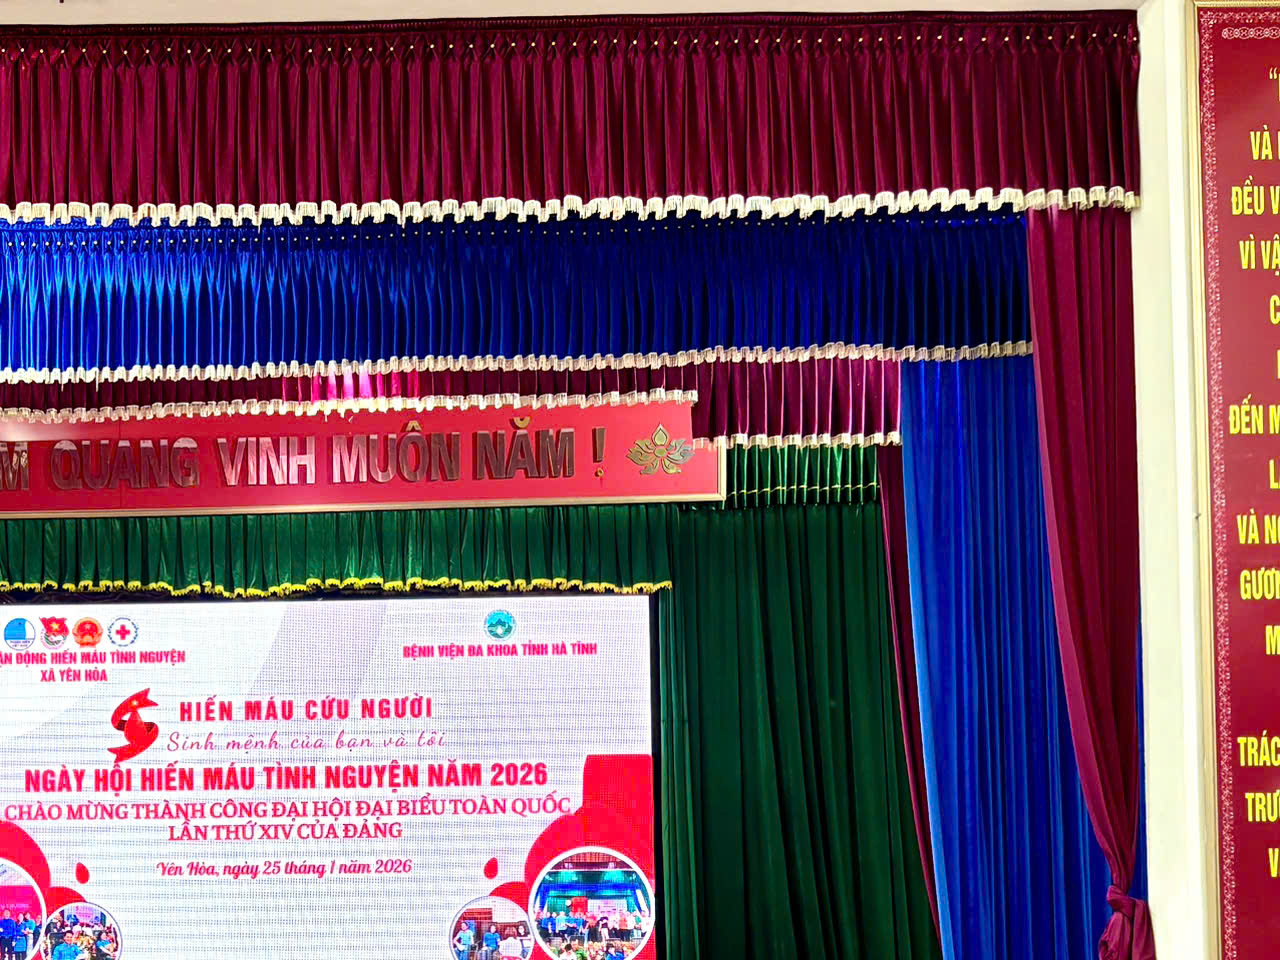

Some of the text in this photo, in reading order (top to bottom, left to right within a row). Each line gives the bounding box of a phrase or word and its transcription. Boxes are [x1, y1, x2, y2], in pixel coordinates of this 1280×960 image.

[1250, 124, 1273, 161] VÀ
[1231, 175, 1265, 215] ĐỀU
[1239, 234, 1256, 270] VÌ
[1229, 393, 1264, 435] ĐẾN
[51, 437, 200, 490] QUANG
[217, 436, 315, 485] VINH
[330, 420, 460, 483] MUÔN
[472, 416, 575, 479] NĂM
[1236, 508, 1260, 545] VÀ
[81, 649, 106, 664] MÁU
[140, 648, 185, 666] NGUYỆN
[403, 643, 434, 661] BỆNH
[438, 642, 465, 660] VIỆN
[487, 643, 518, 657] KHOA
[552, 640, 568, 656] HÀ
[59, 667, 81, 682] YÊN
[180, 692, 432, 721] HIẾN MÁU CỨU NGƯỜI
[167, 729, 445, 754] Sinh mệnh của bạn và tôi
[25, 759, 548, 797] NGÀY HỘI HIẾN MÁU TÌNH NGUYỆN NĂM 2026
[4, 790, 571, 822] CHÀO MỪNG THÀNH CÔNG ĐẠI HỘI ĐẠI BIỂU TOÀN QUỐC
[211, 820, 258, 841] THỨ
[258, 825, 294, 840] XIV
[297, 819, 339, 840] CỦA
[343, 819, 403, 839] ĐẢNG
[157, 859, 412, 879] Yên Hòa, ngày 25 tháng 1 năm 2026
